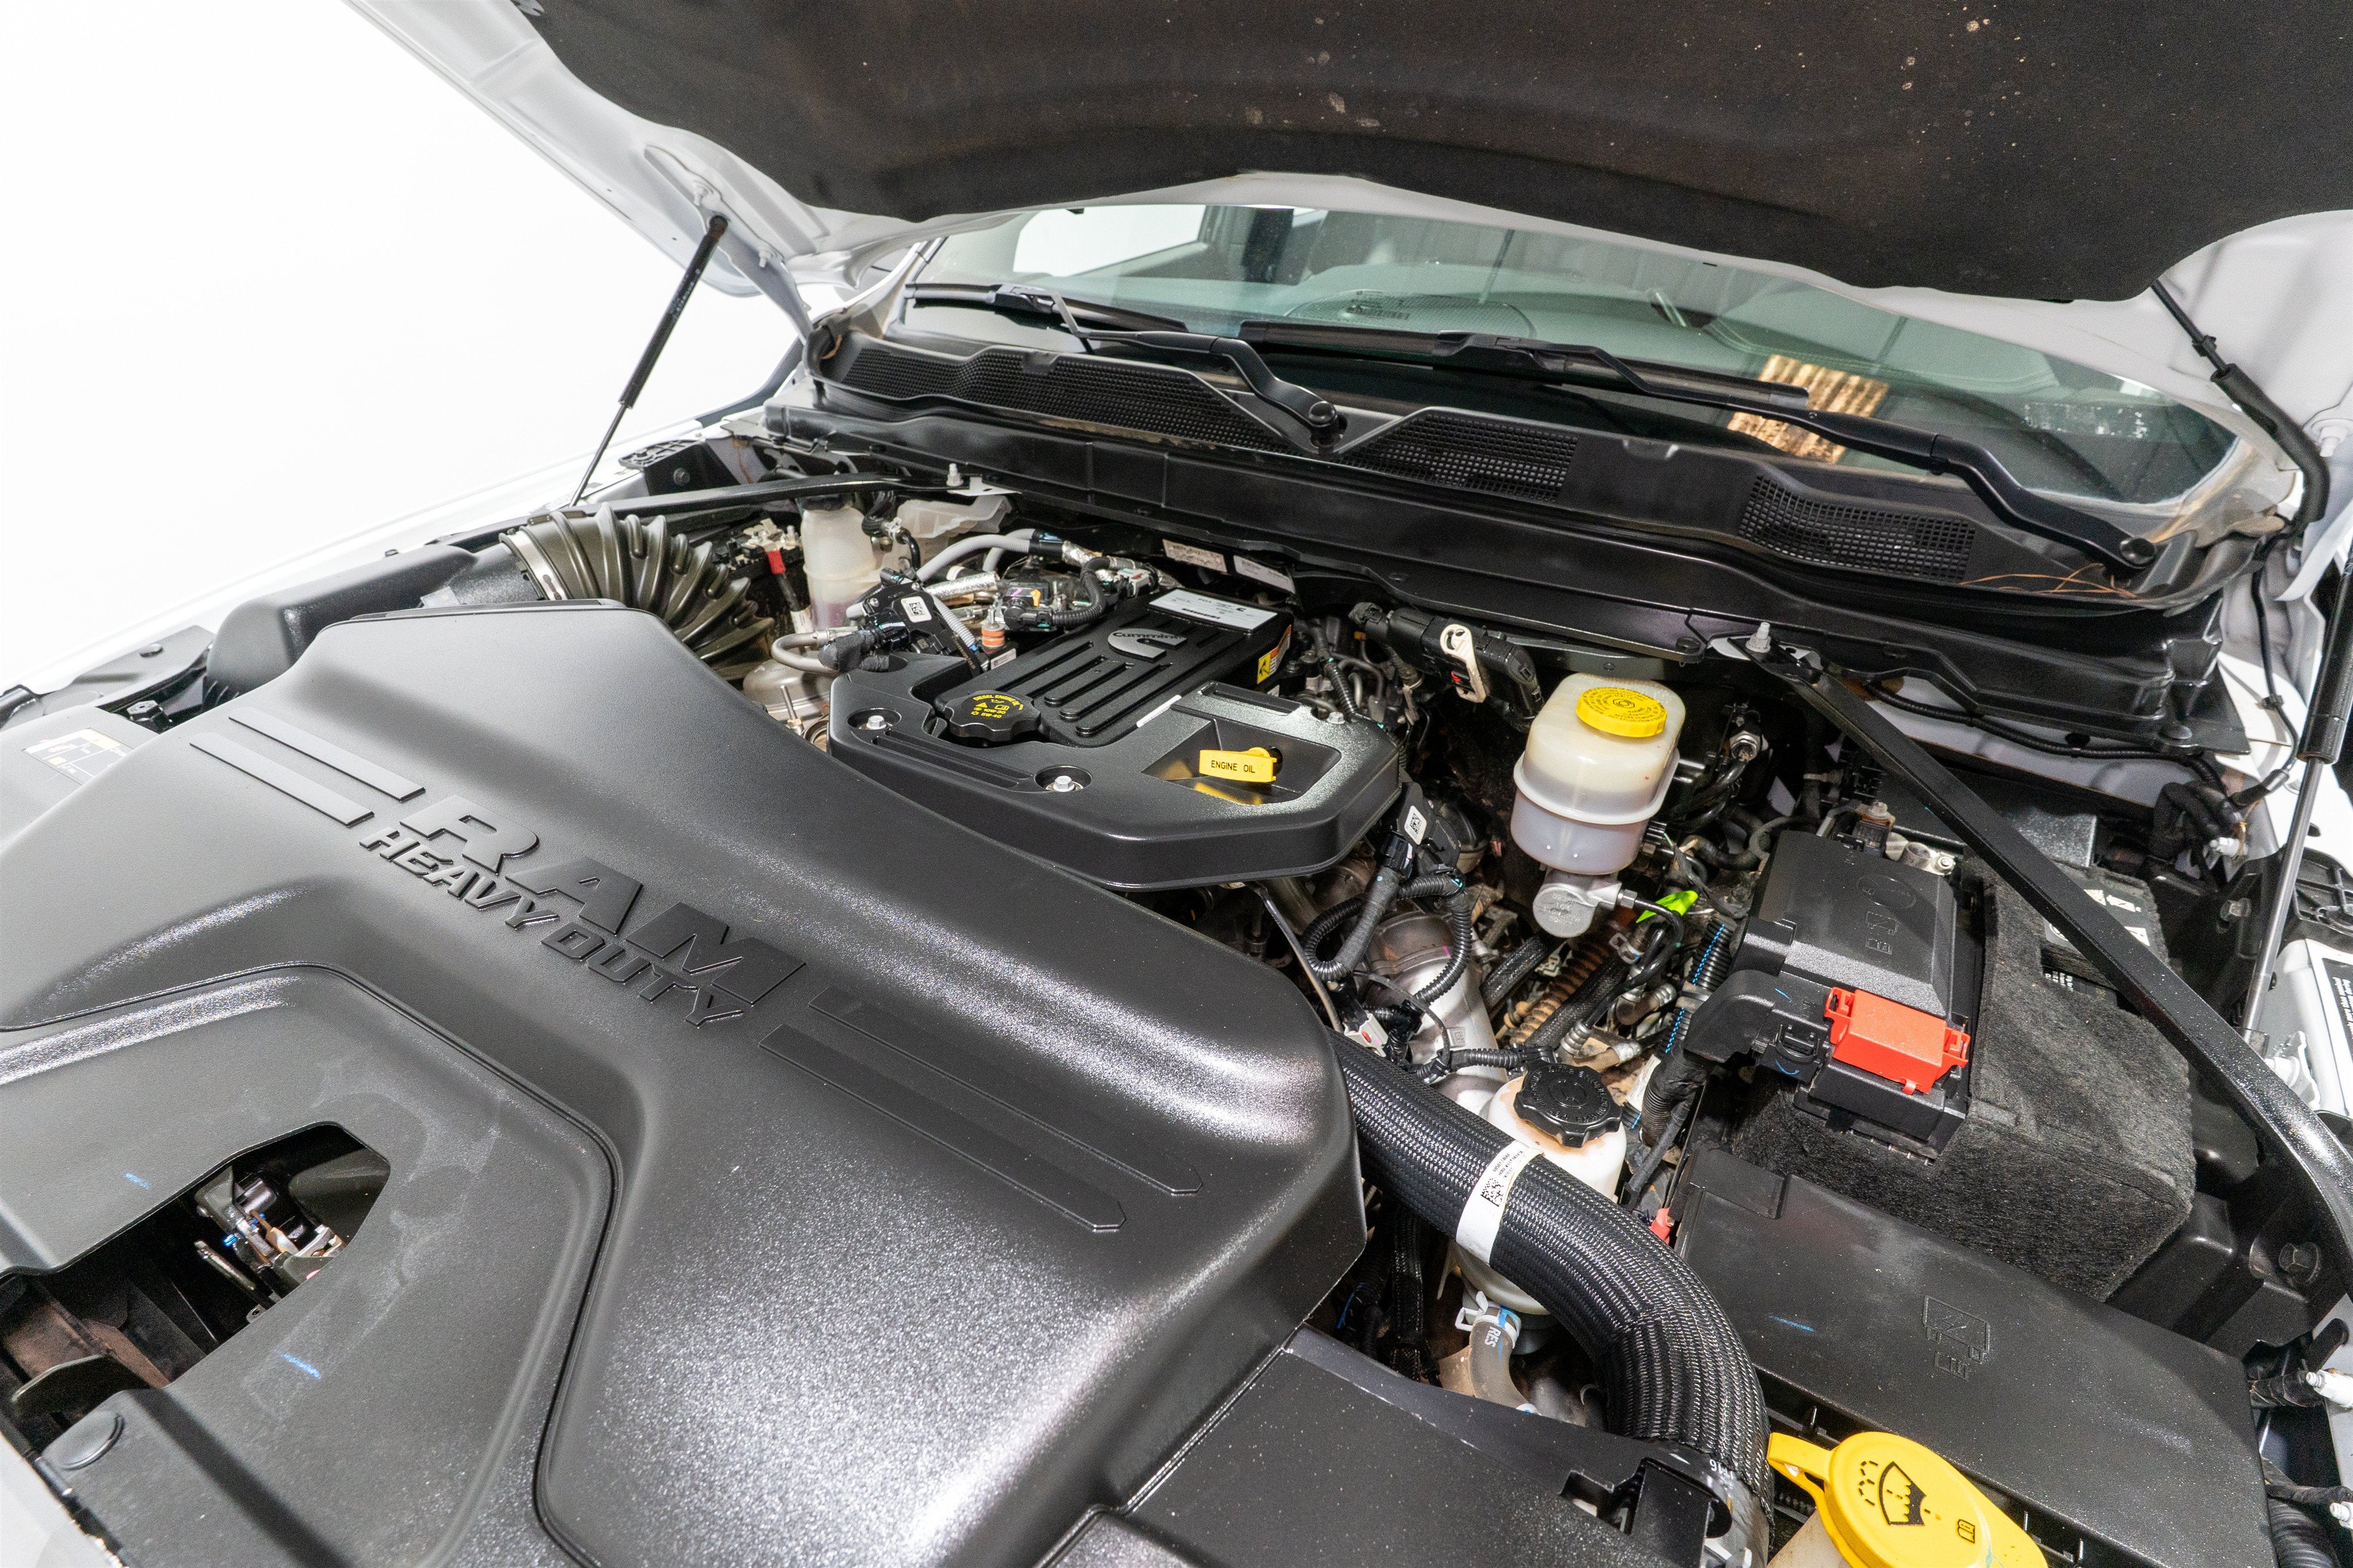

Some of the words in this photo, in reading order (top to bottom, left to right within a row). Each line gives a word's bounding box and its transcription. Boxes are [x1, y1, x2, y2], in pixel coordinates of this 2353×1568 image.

[995, 694, 1016, 702] ENGINE
[1211, 760, 1237, 771] ENGINE
[1243, 764, 1255, 773] OIL
[400, 794, 807, 1006] RAM
[359, 826, 560, 930] HEAVY
[541, 920, 745, 1027] DUTY
[1484, 1326, 1502, 1347] RES
